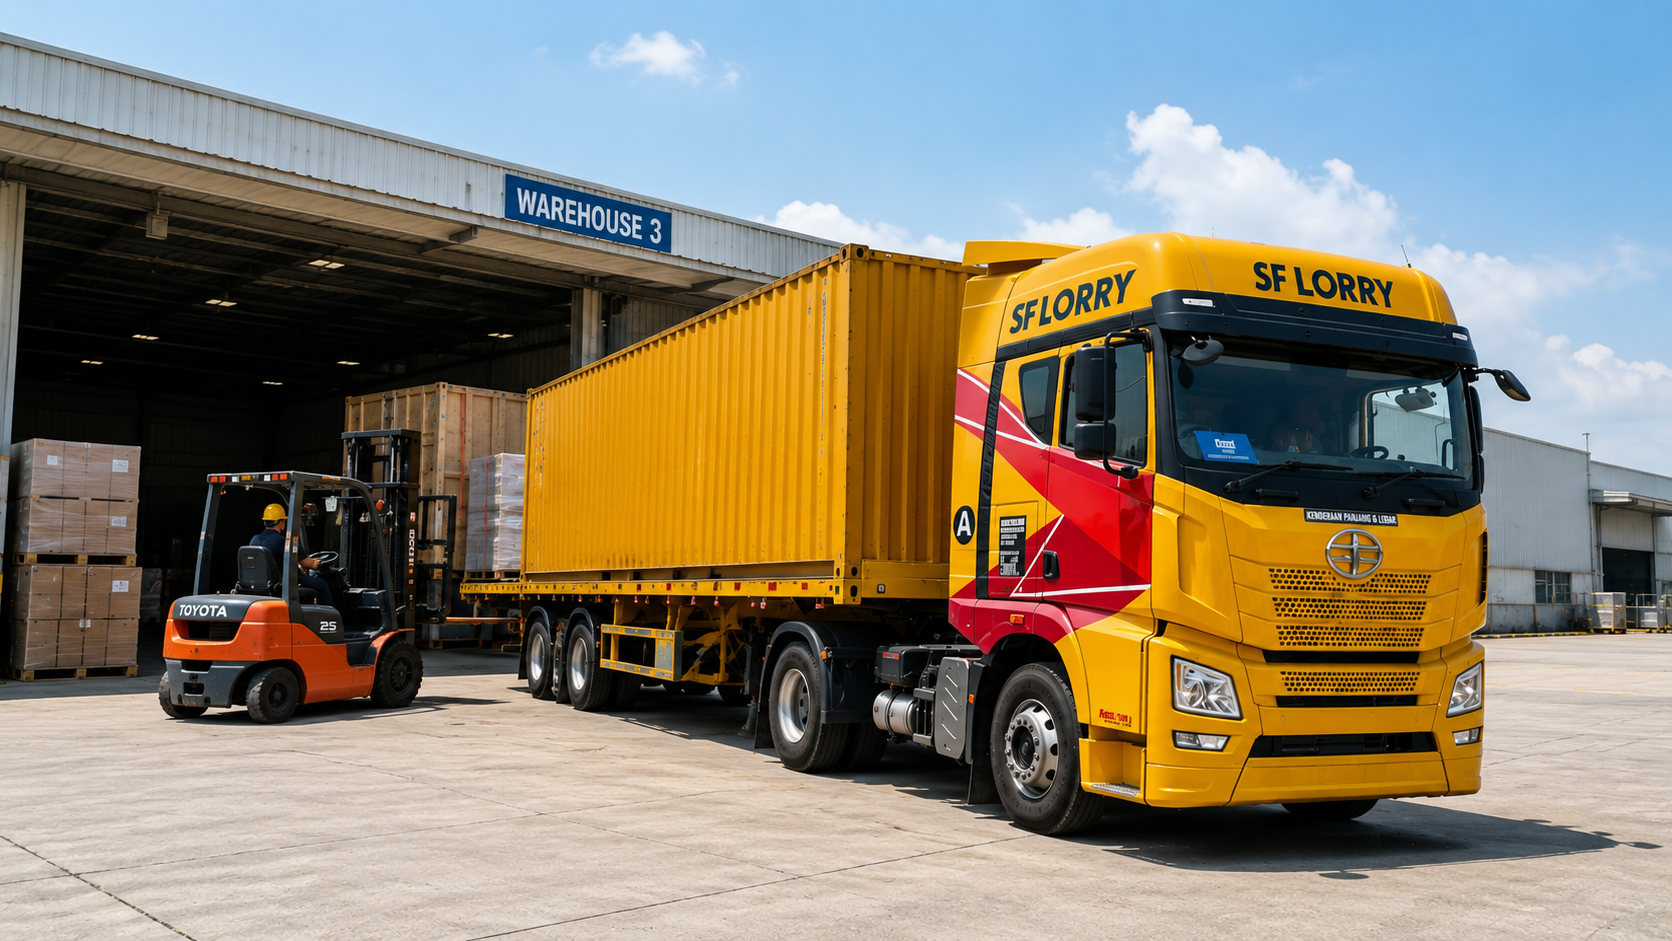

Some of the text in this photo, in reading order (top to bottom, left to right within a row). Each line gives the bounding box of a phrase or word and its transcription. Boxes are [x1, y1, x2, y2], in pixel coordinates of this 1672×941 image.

[517, 187, 662, 244] WAREHOUSE 3
[1009, 269, 1137, 334] SF LORRY
[1253, 261, 1393, 308] SF LORRY
[956, 510, 972, 537] A
[179, 604, 227, 618] TOYOTA
[319, 621, 337, 631] 25
